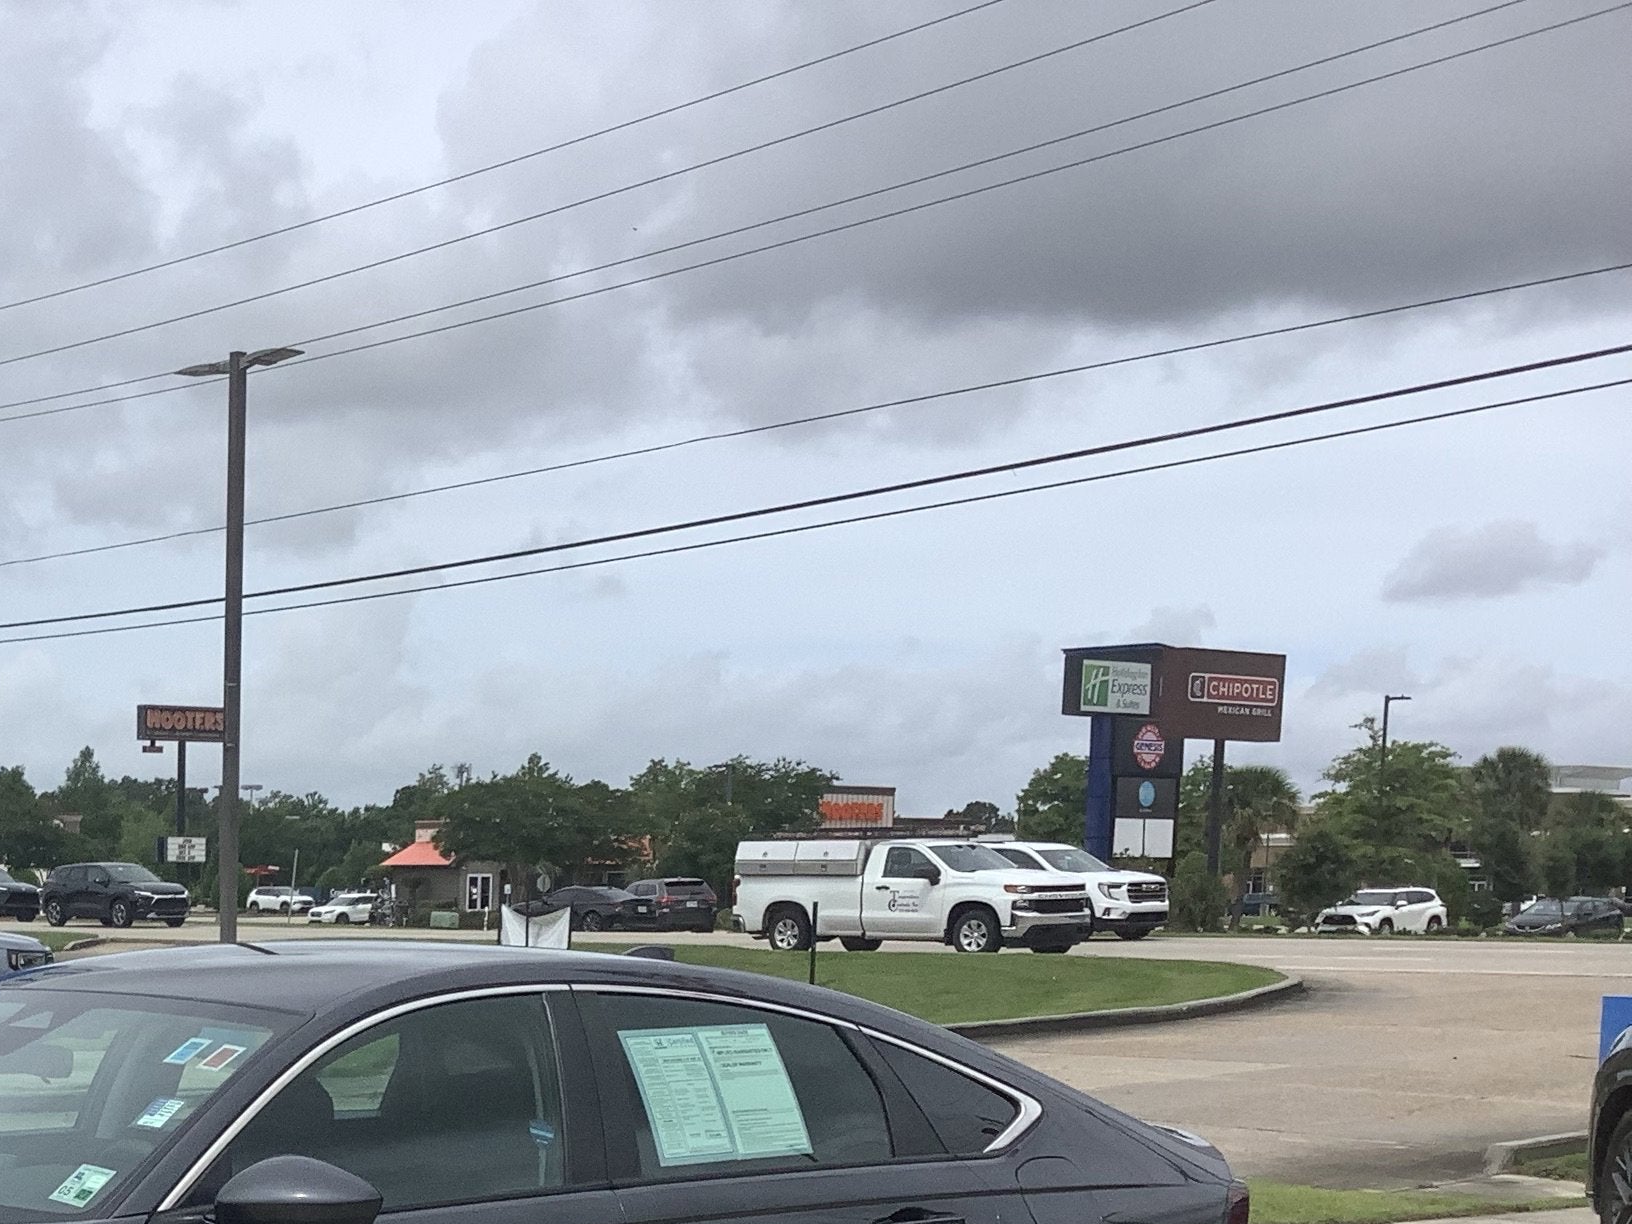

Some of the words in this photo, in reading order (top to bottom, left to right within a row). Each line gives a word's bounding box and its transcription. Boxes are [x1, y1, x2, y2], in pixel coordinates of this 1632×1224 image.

[1111, 679, 1148, 698] Express
[1209, 681, 1274, 699] CHIPOTLE
[146, 709, 224, 731] HOOTERS
[1217, 705, 1250, 715] MEXICAN
[1251, 707, 1272, 717] GRILL
